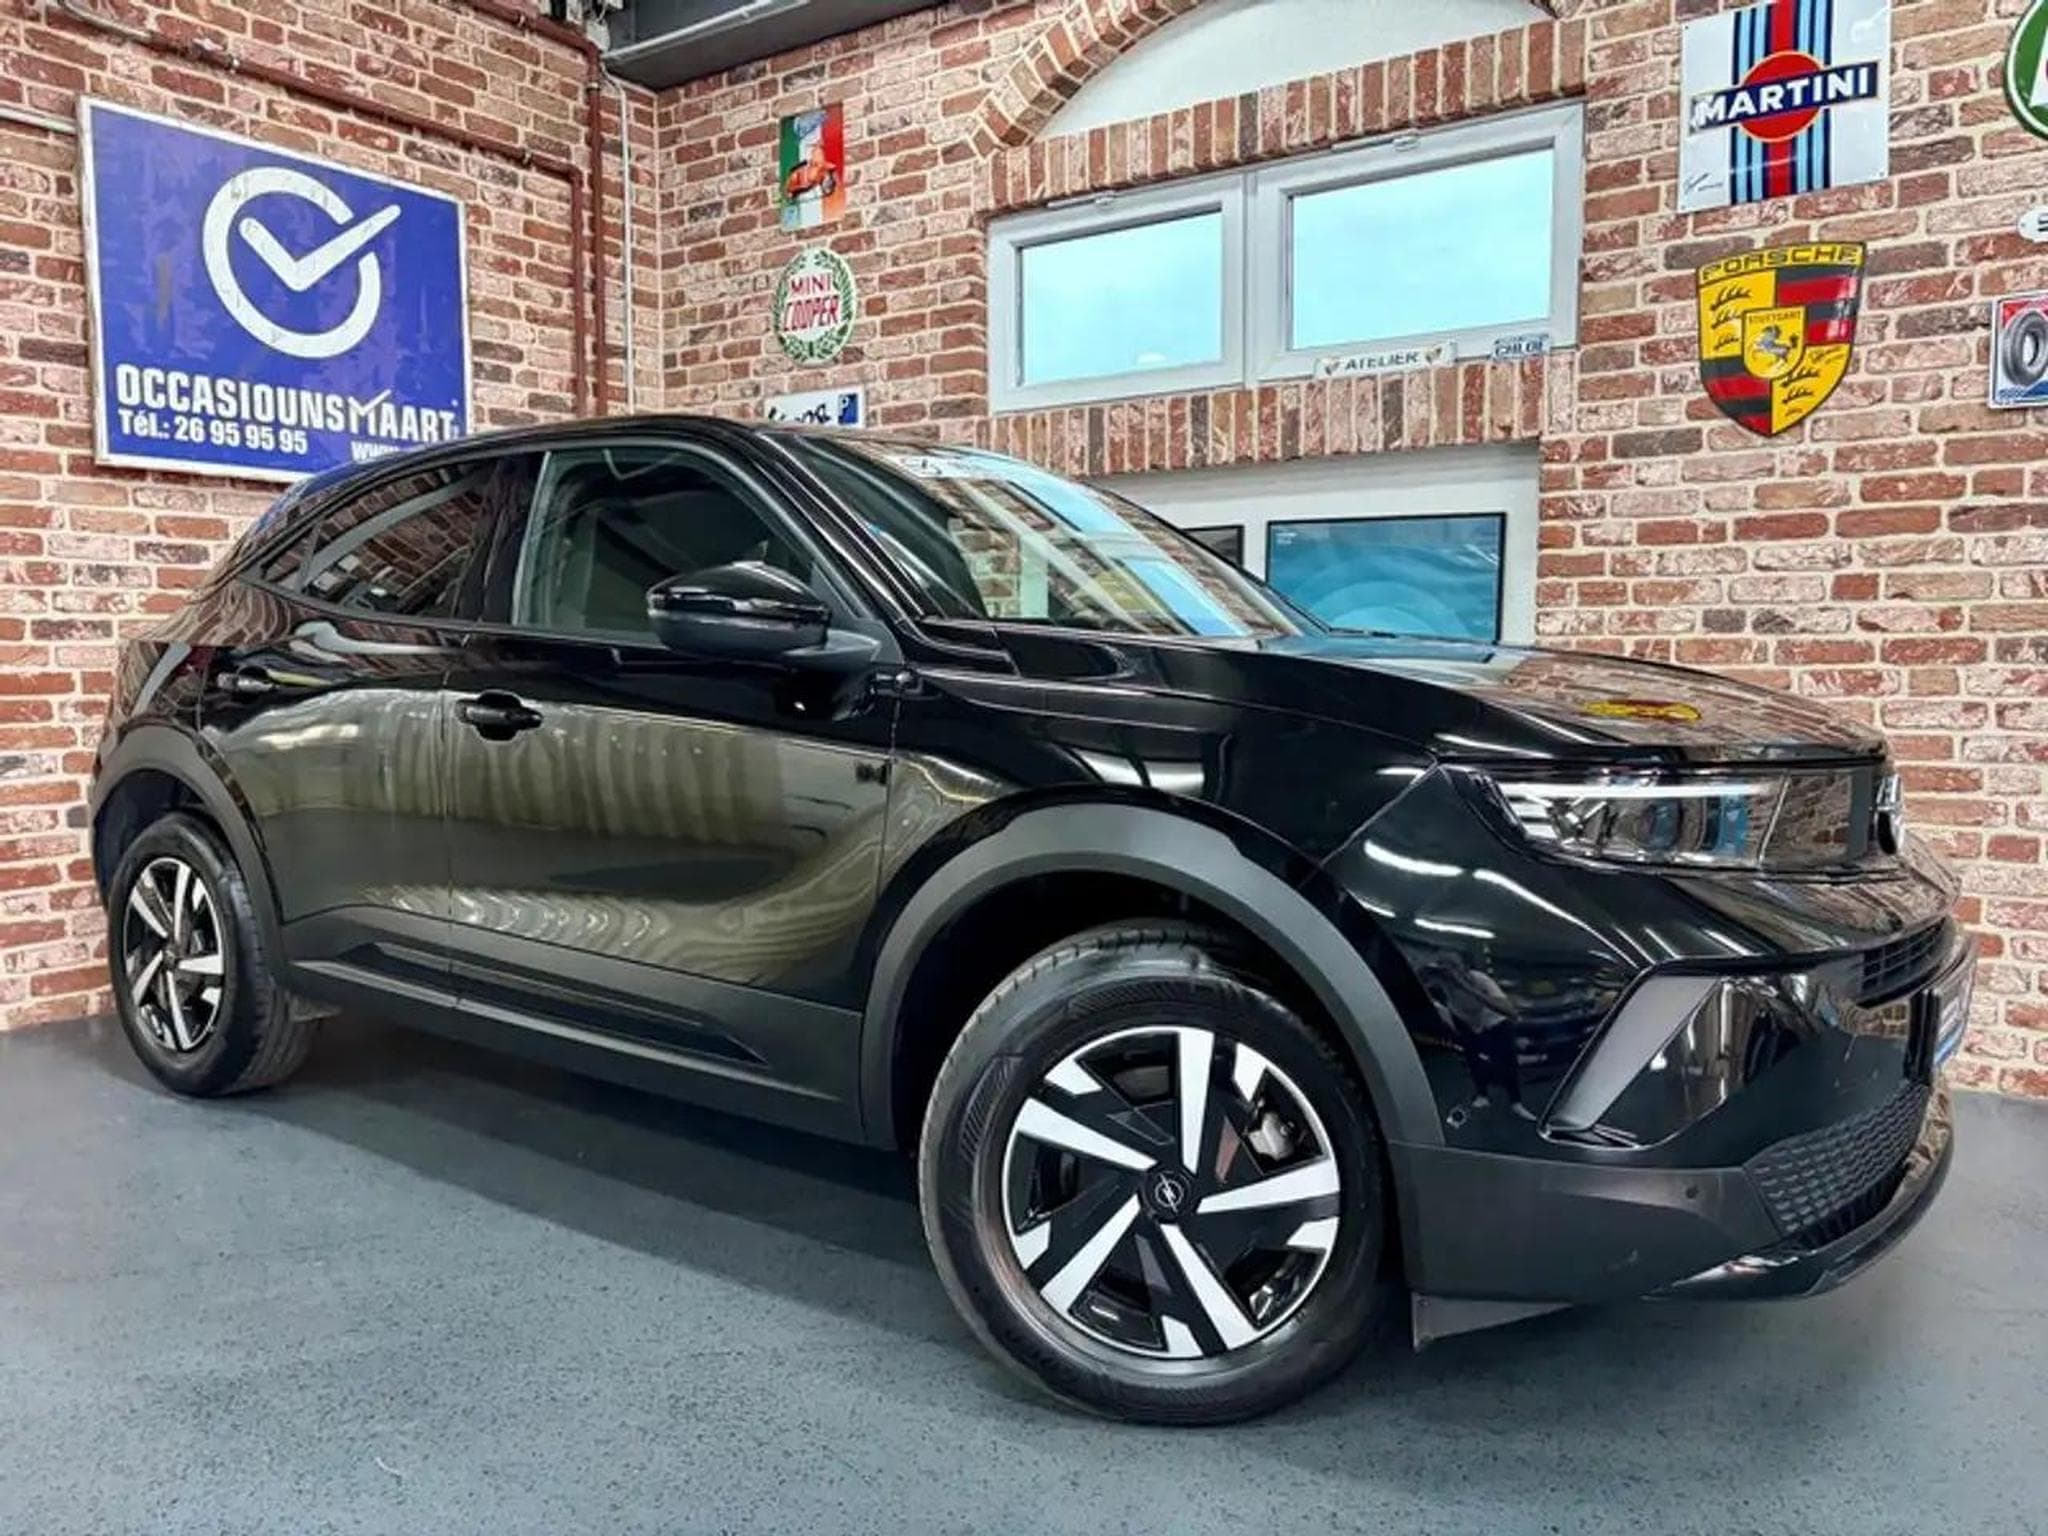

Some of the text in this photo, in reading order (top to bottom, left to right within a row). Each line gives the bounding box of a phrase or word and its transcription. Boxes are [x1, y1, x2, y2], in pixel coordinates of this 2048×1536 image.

[1692, 67, 1869, 127] MARTINI
[1703, 244, 1858, 280] PORSCHE
[791, 272, 831, 296] MINI
[784, 295, 839, 331] COOPER
[1345, 352, 1419, 371] ATELIER
[174, 415, 204, 443] 26
[210, 418, 240, 447] 95
[245, 422, 274, 451] 95
[279, 426, 308, 455] 95
